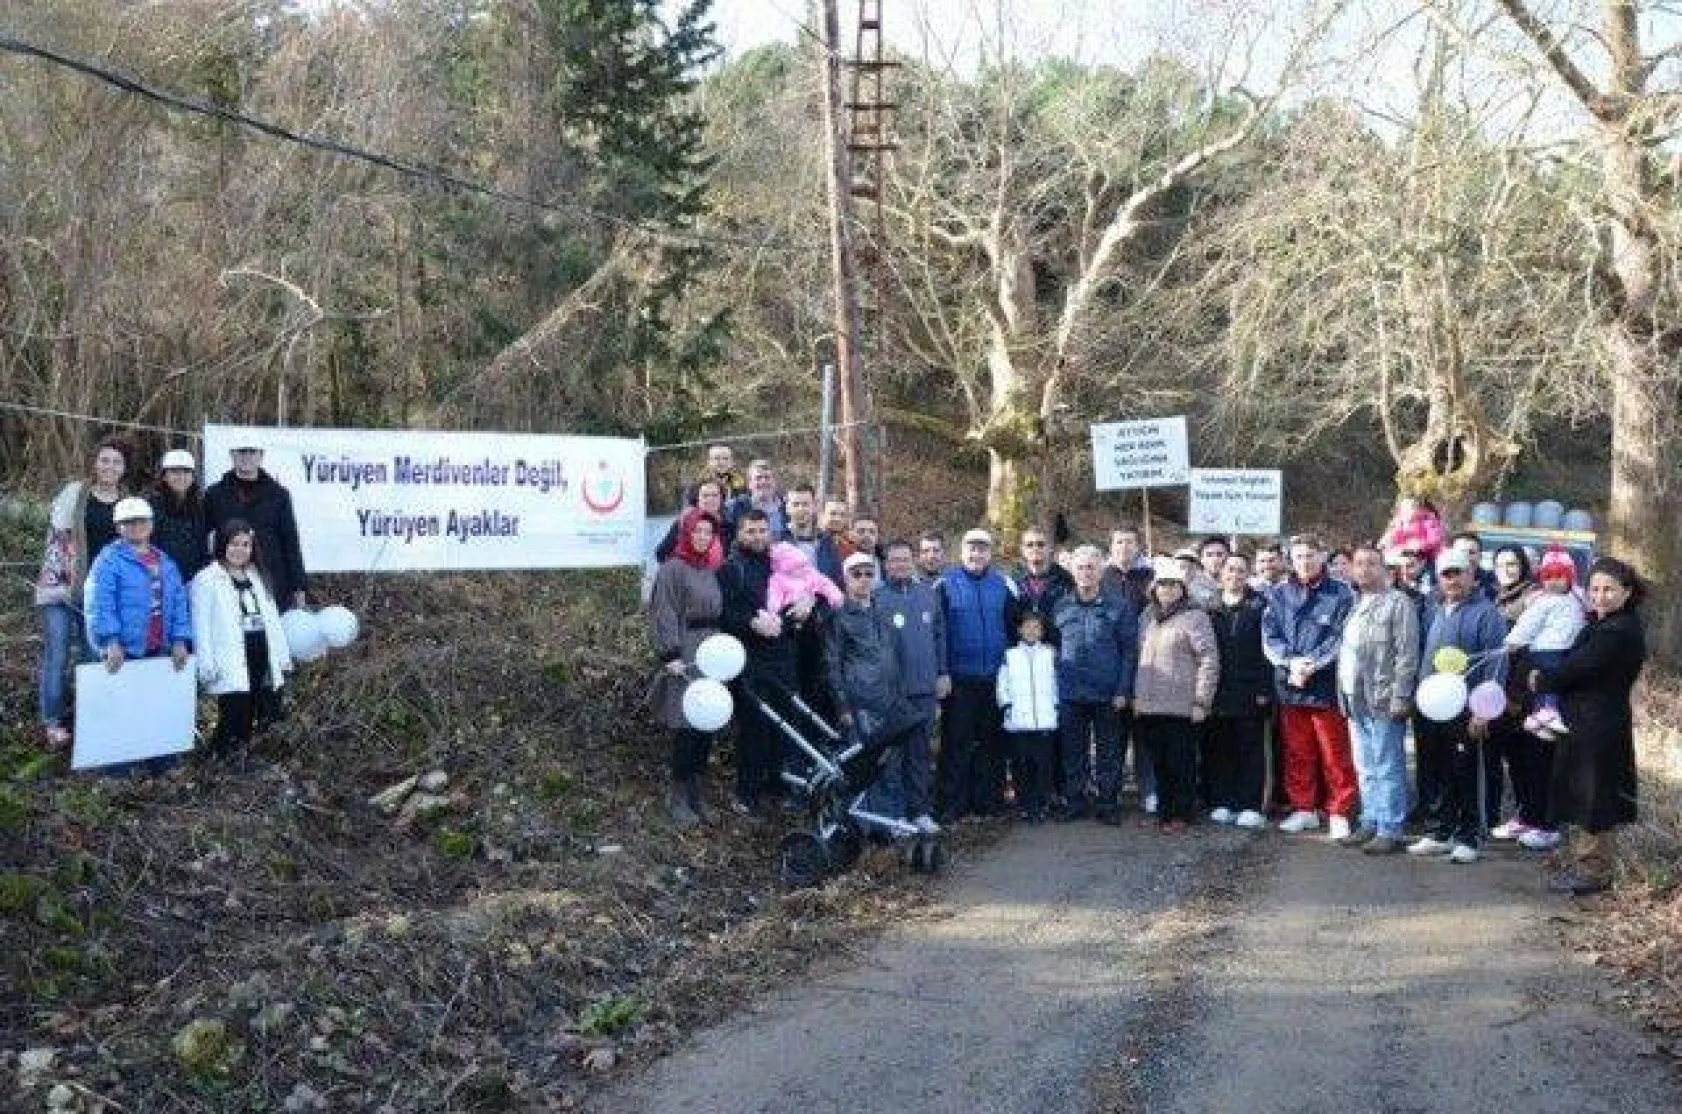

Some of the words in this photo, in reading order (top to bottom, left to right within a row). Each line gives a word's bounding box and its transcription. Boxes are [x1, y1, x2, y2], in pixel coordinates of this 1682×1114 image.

[302, 454, 387, 491] Yürüyen
[394, 456, 509, 485] Merdivenler
[515, 459, 569, 493] Değil,
[357, 509, 440, 544] Yürüyen
[447, 510, 520, 544] Ayaklar
